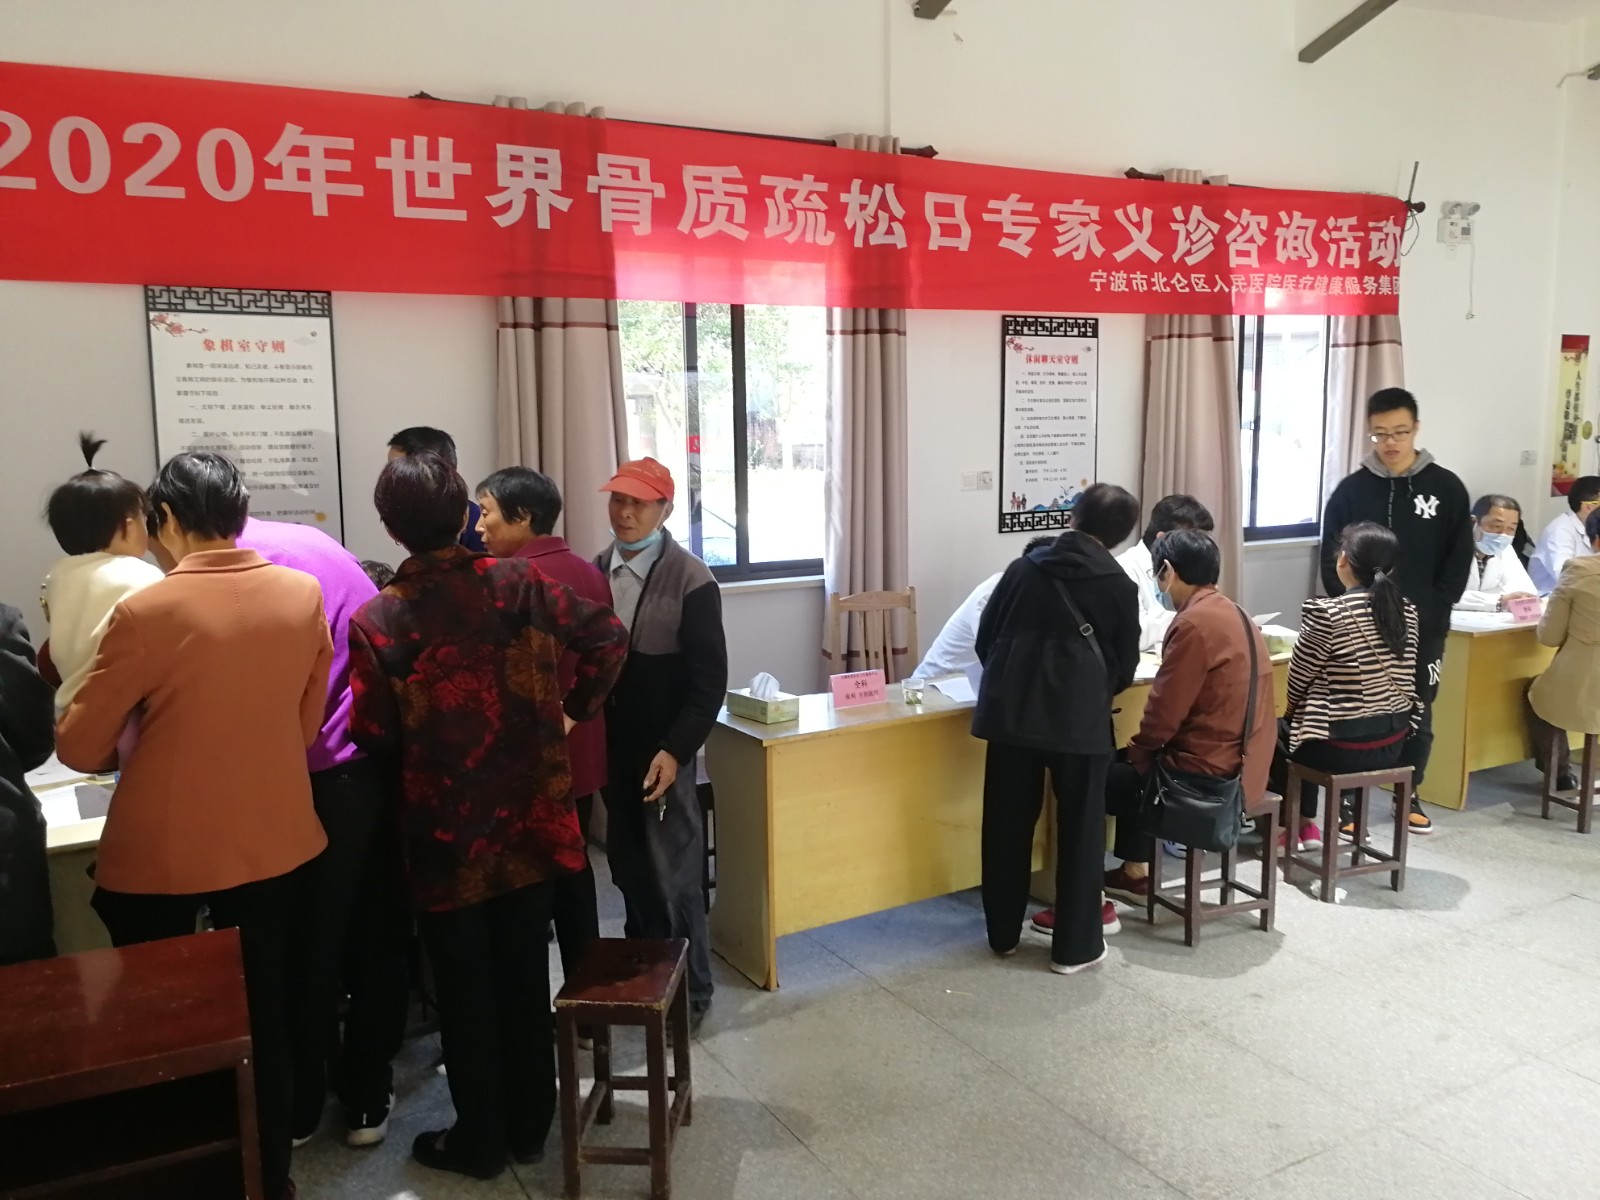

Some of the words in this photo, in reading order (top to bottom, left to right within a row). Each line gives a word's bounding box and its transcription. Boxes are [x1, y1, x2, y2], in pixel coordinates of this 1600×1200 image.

[203, 338, 286, 353] 象棋室守则
[1026, 355, 1078, 365] 休闲聊天室守则
[1413, 494, 1441, 519] NY
